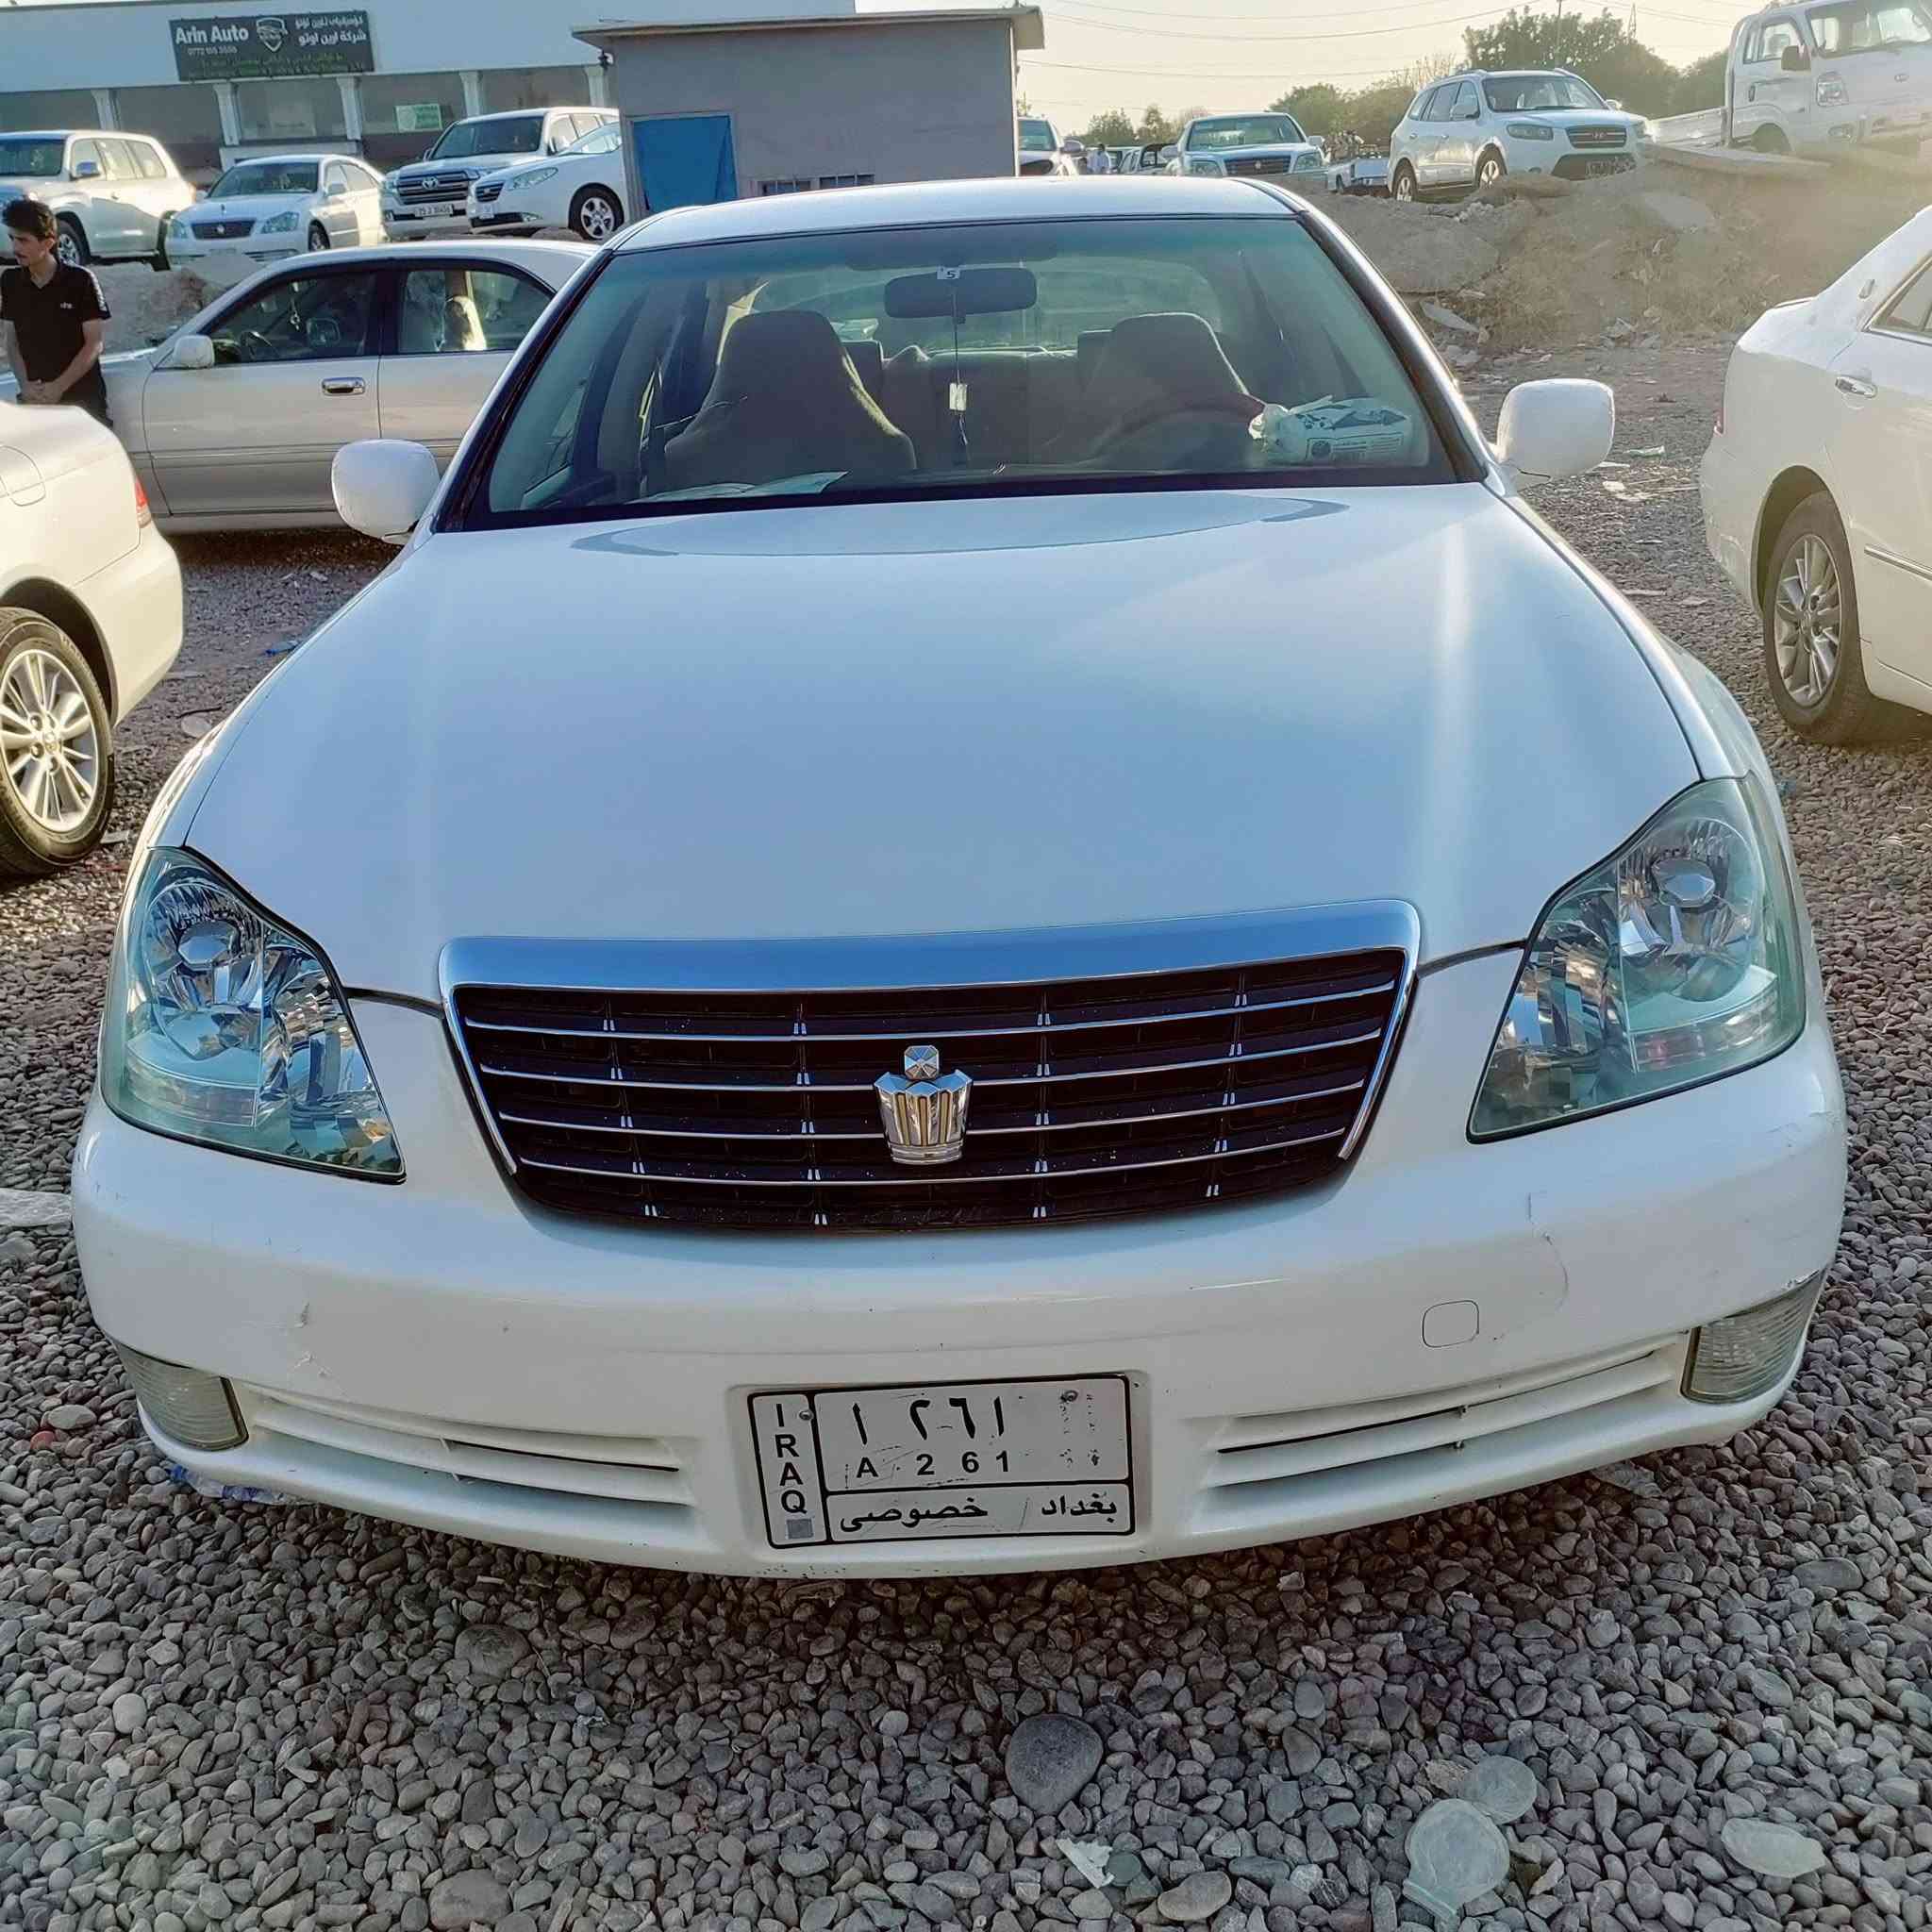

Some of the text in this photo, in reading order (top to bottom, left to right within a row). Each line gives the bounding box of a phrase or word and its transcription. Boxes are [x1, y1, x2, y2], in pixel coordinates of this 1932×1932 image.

[175, 25, 249, 44] Arin Auto
[774, 1403, 808, 1515] IRAQ
[1041, 1492, 1118, 1524] بغداد
